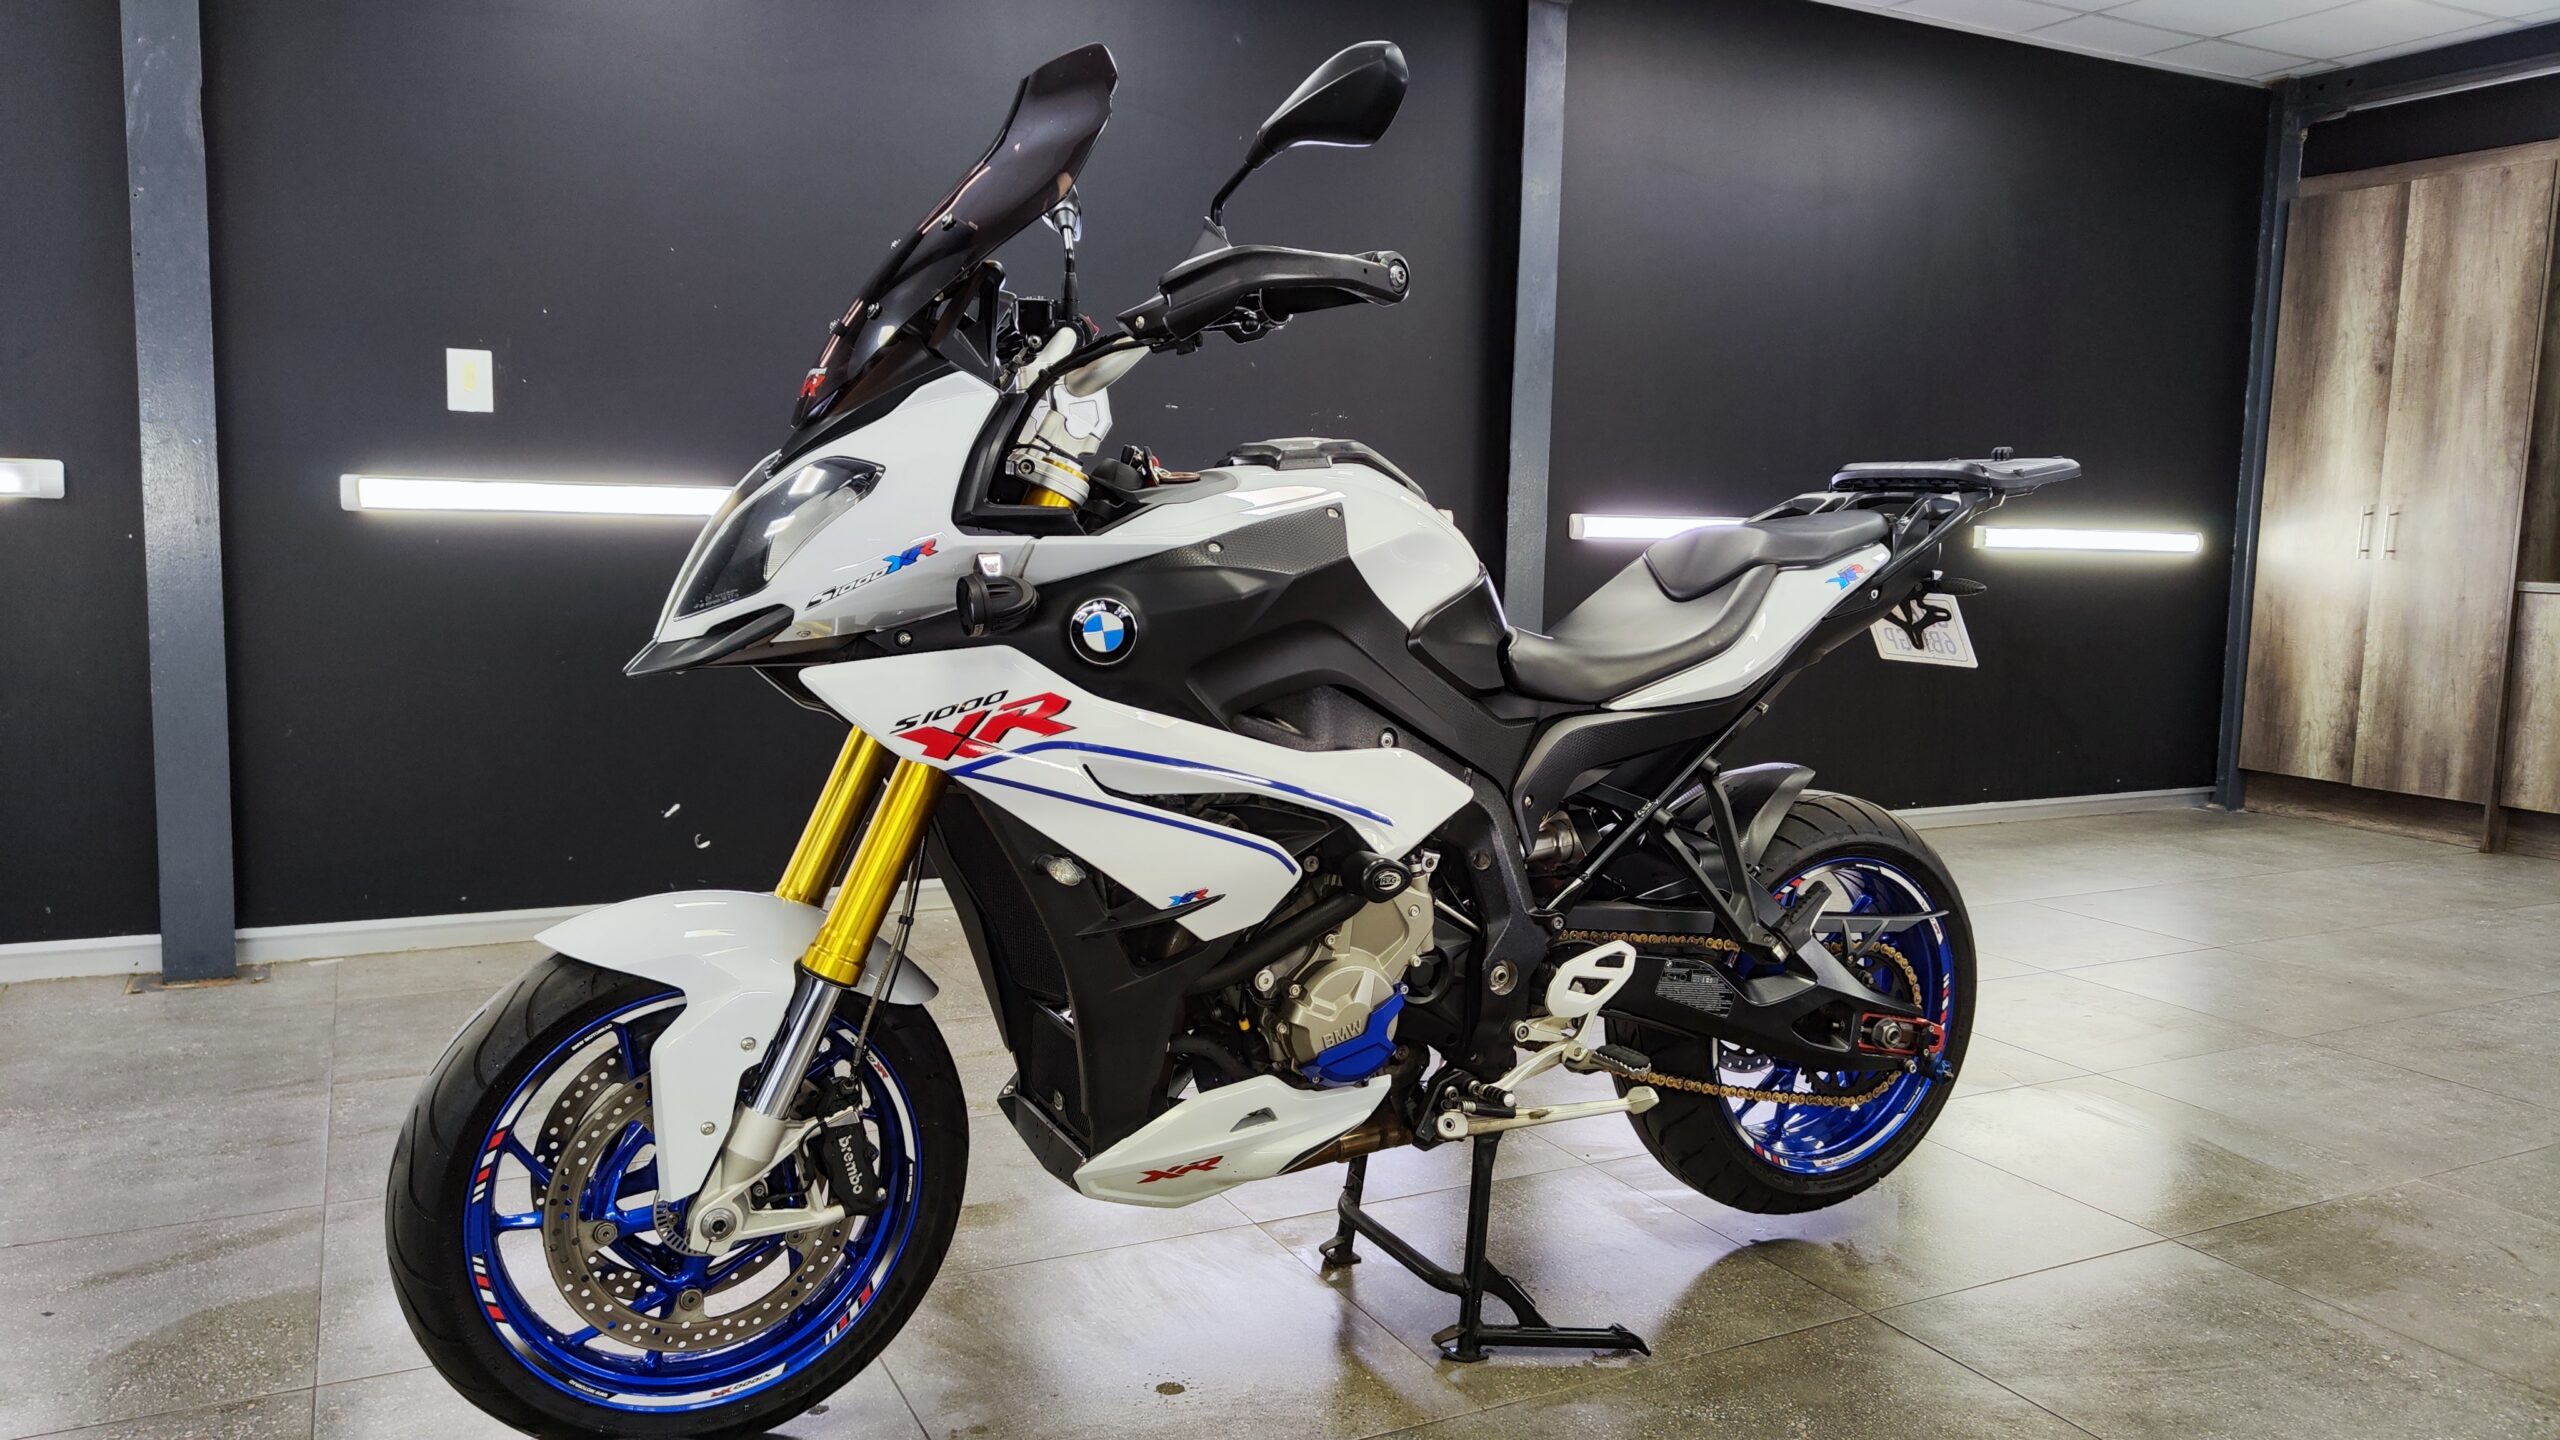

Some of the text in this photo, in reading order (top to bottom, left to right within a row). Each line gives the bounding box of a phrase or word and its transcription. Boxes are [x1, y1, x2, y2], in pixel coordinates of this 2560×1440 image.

[805, 565, 889, 611] S1000
[1073, 600, 1131, 625] BMW
[889, 689, 1009, 734] S1000
[896, 691, 1078, 761] XR
[1321, 1018, 1364, 1049] BMW
[838, 1134, 863, 1195] brembo
[1136, 1154, 1225, 1184] XR
